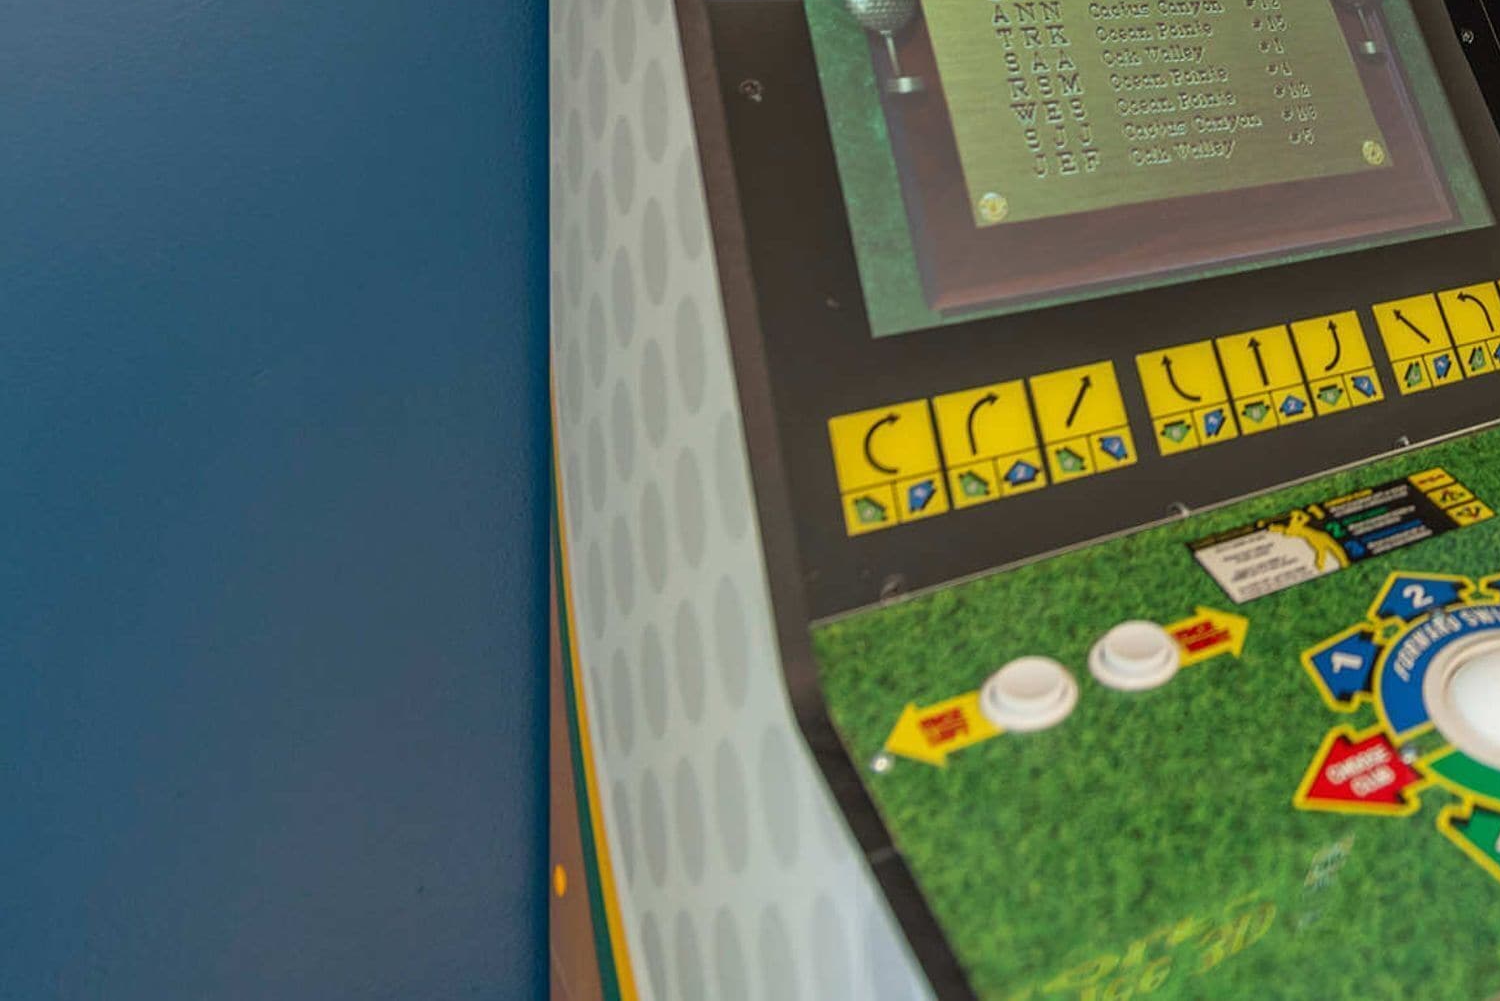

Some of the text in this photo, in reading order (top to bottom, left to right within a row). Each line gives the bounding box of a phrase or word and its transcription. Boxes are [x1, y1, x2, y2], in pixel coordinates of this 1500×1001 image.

[994, 1, 1061, 23] ANN
[1403, 585, 1434, 609] 2
[1332, 650, 1363, 675] 1
